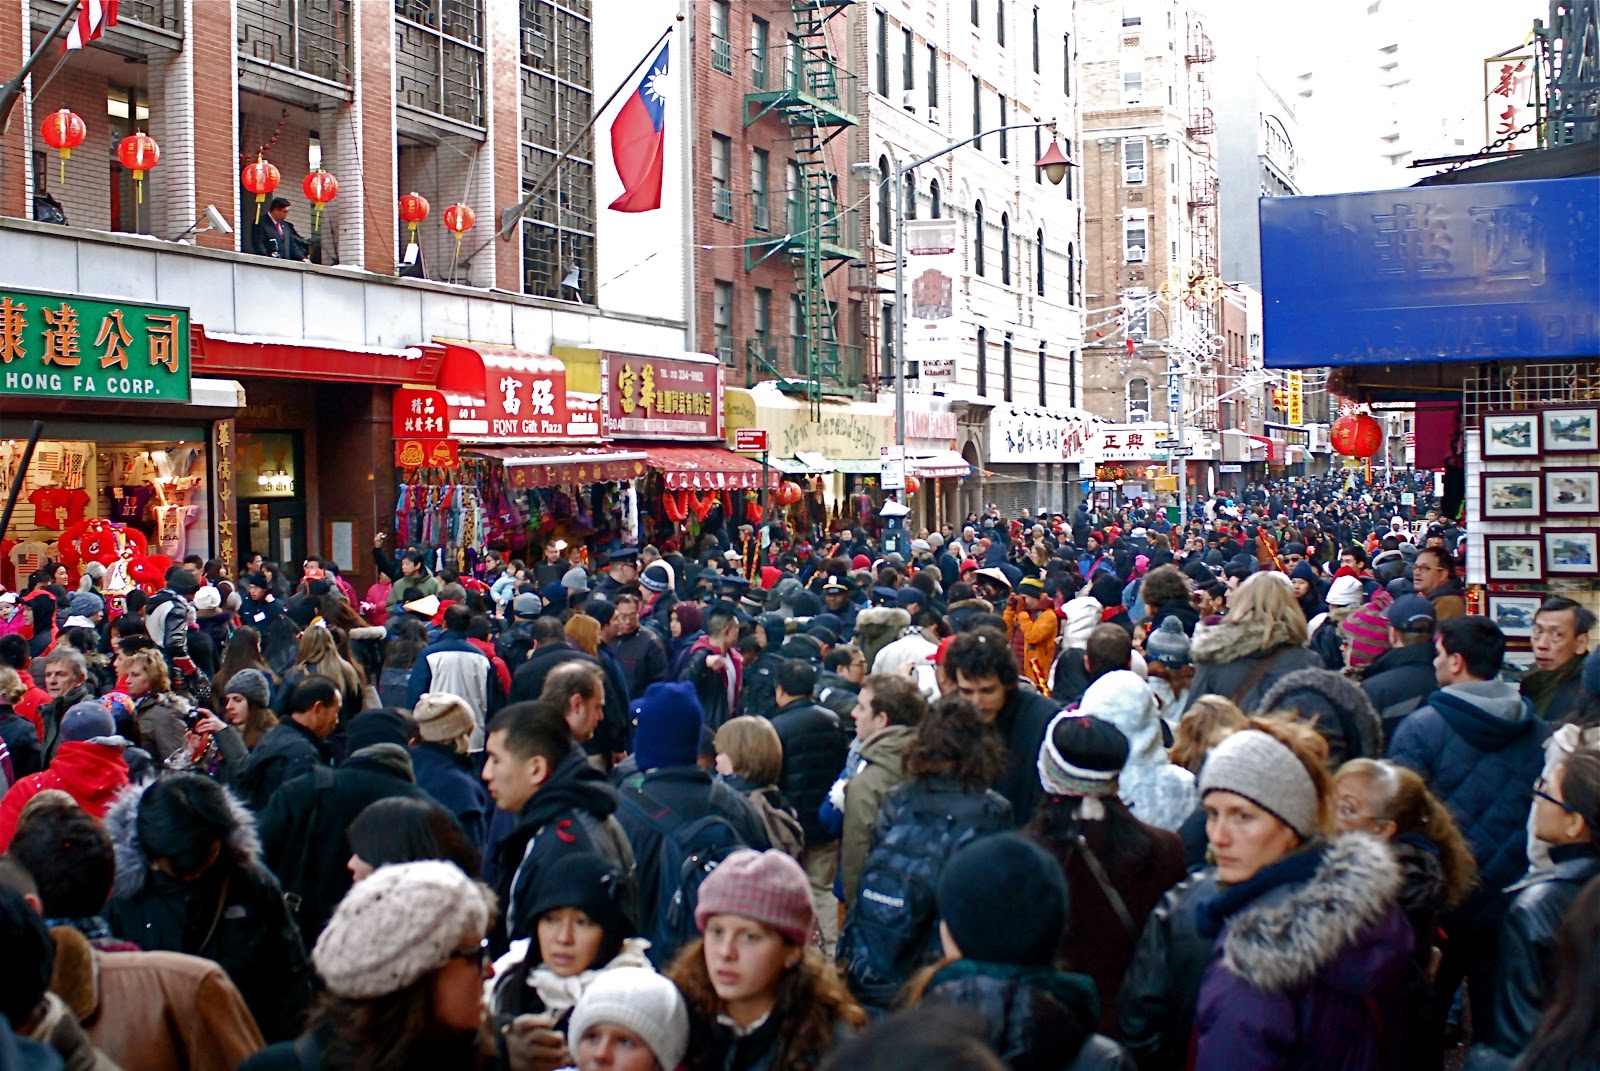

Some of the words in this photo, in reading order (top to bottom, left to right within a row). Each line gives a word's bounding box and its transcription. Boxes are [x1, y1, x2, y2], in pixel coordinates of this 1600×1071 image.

[0, 297, 180, 374] 康達公司
[6, 372, 62, 391] HONG
[73, 375, 96, 392] FA
[107, 377, 160, 394] CORP.
[493, 419, 518, 436] FQNY
[521, 419, 538, 434] Gift
[541, 420, 563, 434] Plaza
[784, 422, 809, 454] New
[1103, 433, 1144, 450] 正興
